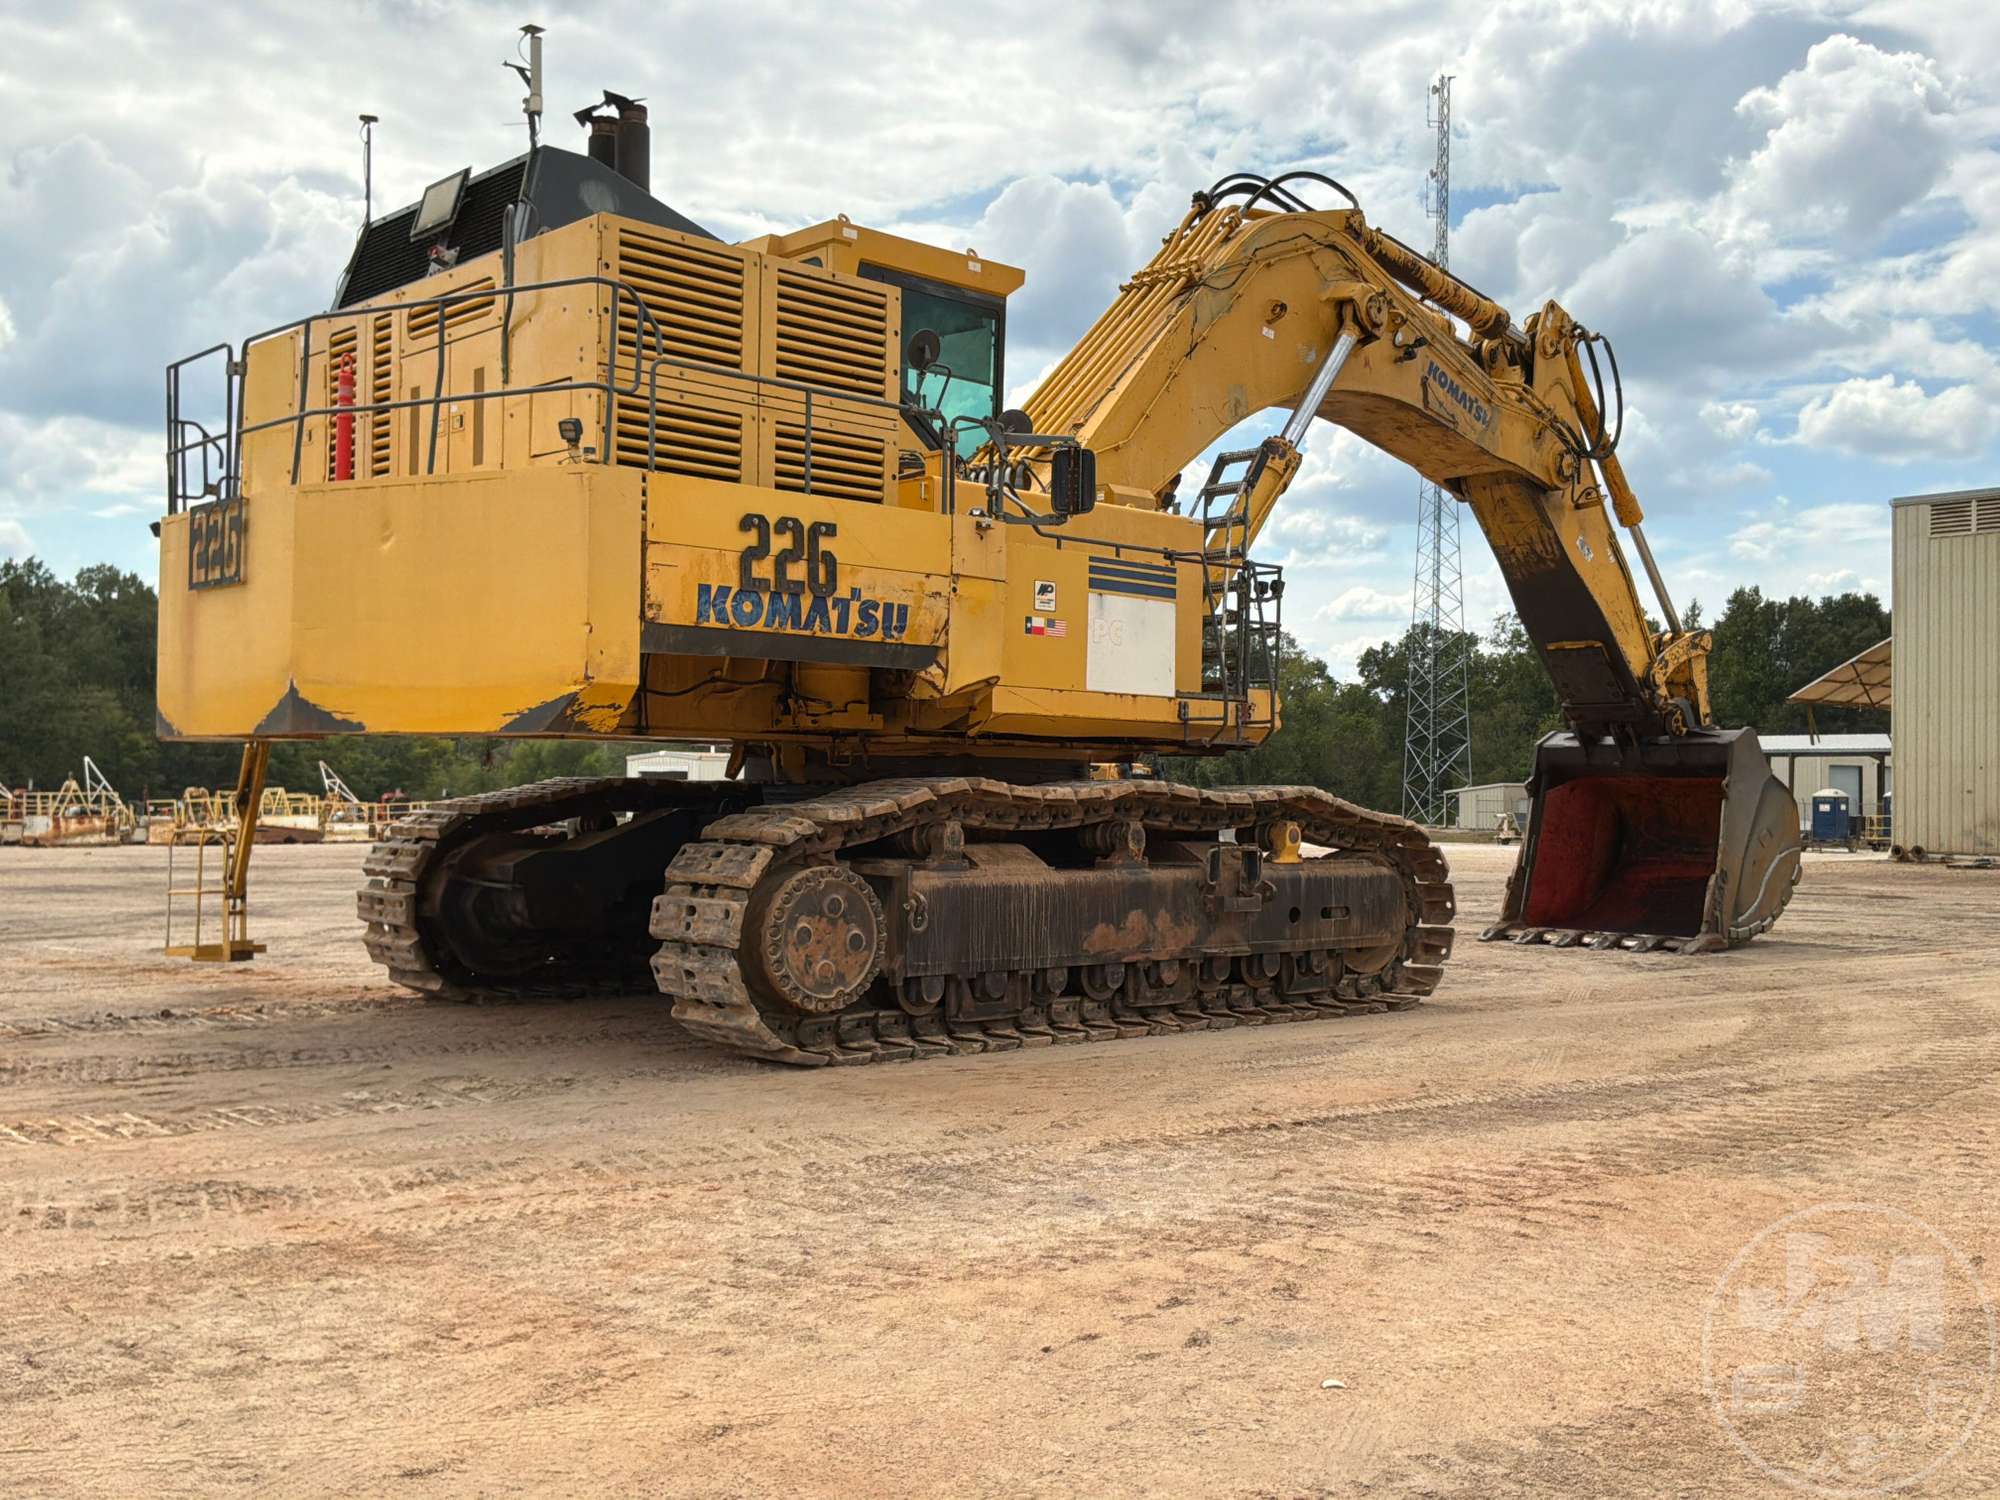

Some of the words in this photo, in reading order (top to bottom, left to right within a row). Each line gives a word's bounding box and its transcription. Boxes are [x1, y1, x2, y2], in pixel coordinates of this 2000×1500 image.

[1427, 359, 1489, 432] KOMATSU
[739, 513, 837, 598] 226
[696, 583, 909, 640] KOMATSU
